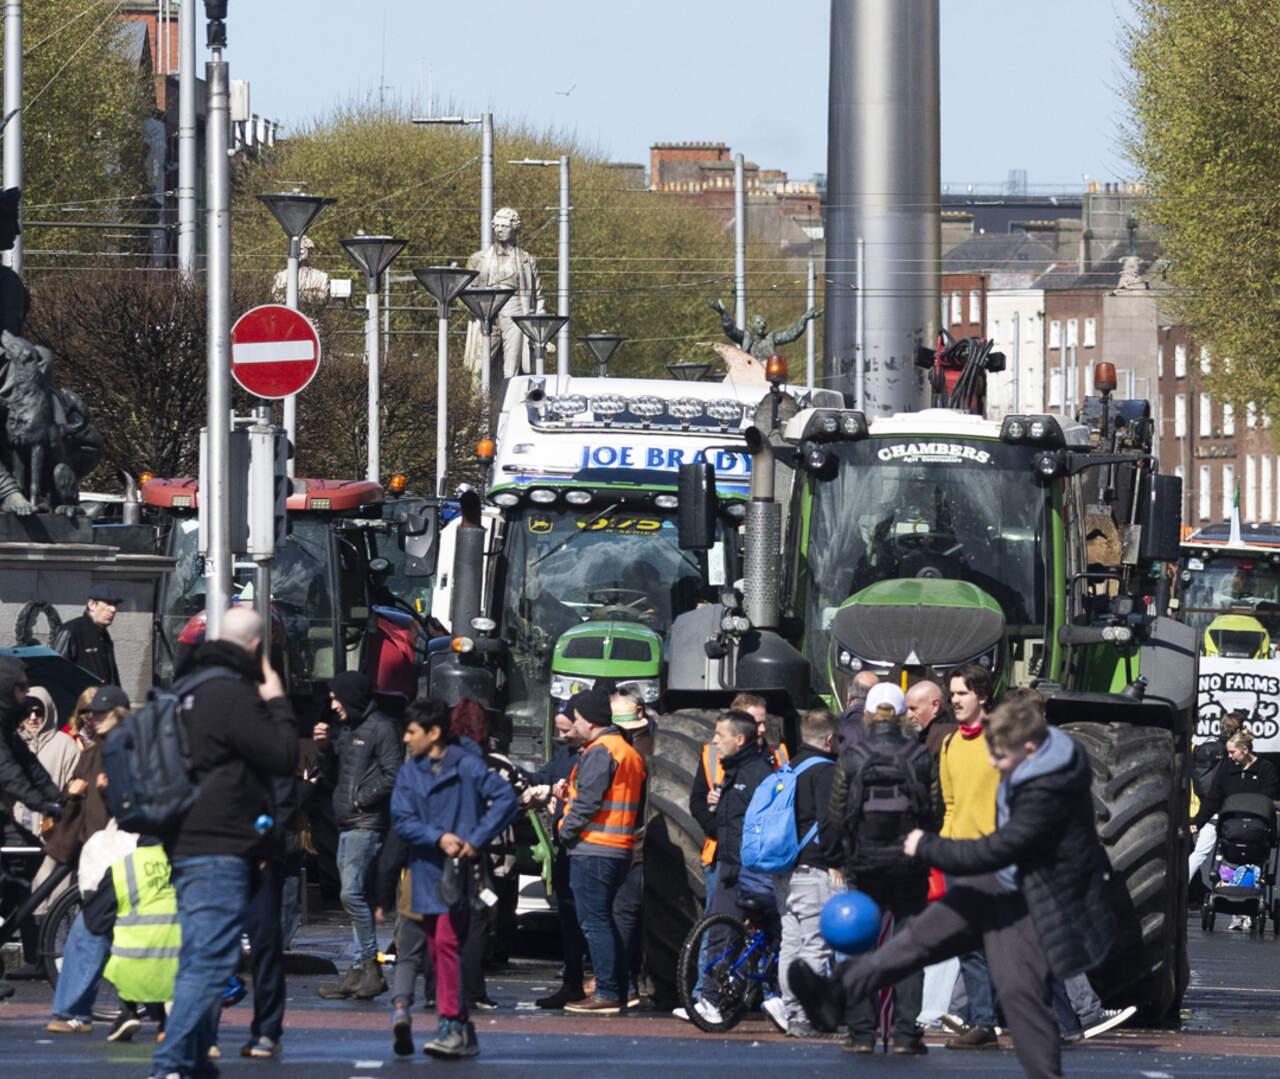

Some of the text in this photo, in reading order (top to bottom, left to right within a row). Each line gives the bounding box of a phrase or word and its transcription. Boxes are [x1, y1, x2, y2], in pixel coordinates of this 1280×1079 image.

[581, 445, 634, 469] JOE
[877, 442, 991, 464] CHAMBERS
[1198, 674, 1280, 694] NO FARMS
[1197, 719, 1220, 736] NO
